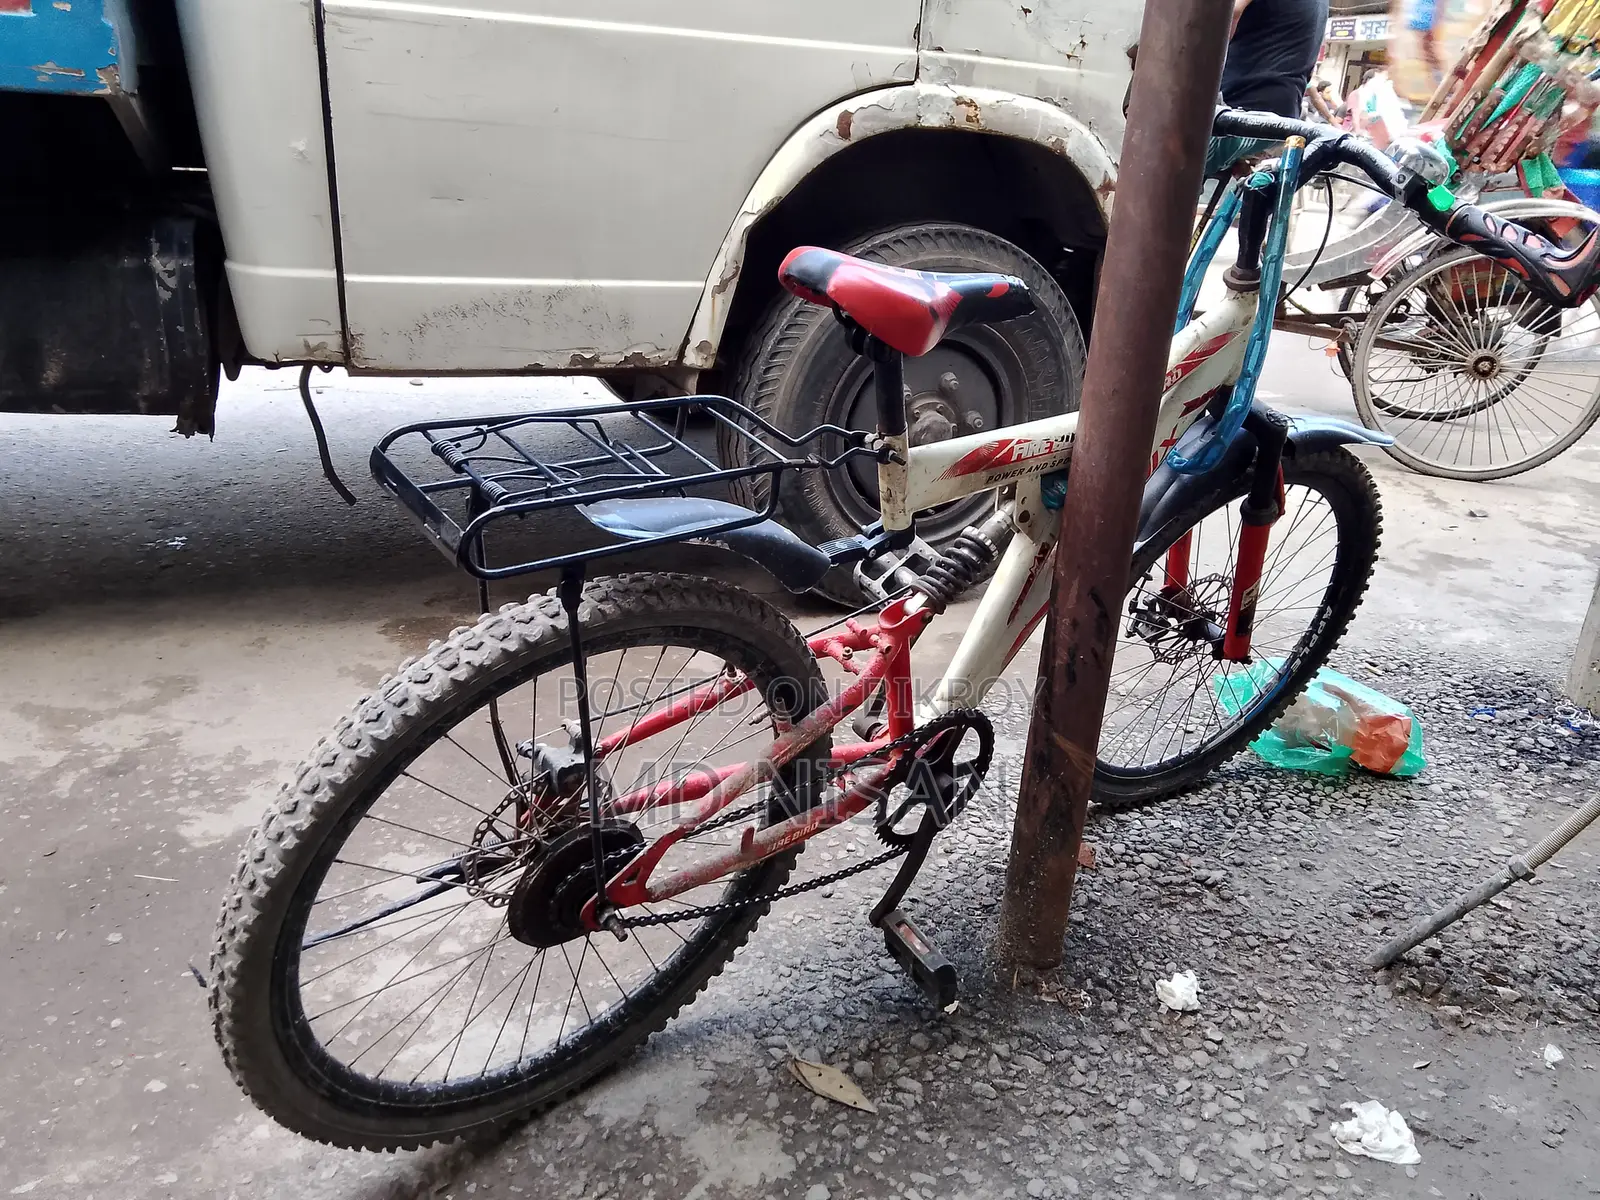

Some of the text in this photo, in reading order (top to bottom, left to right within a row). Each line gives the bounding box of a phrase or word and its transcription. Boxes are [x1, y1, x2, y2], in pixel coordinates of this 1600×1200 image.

[986, 457, 1071, 484] POWER AND SPO
[1290, 605, 1333, 673] APPLE
[791, 821, 819, 840] BIRD
